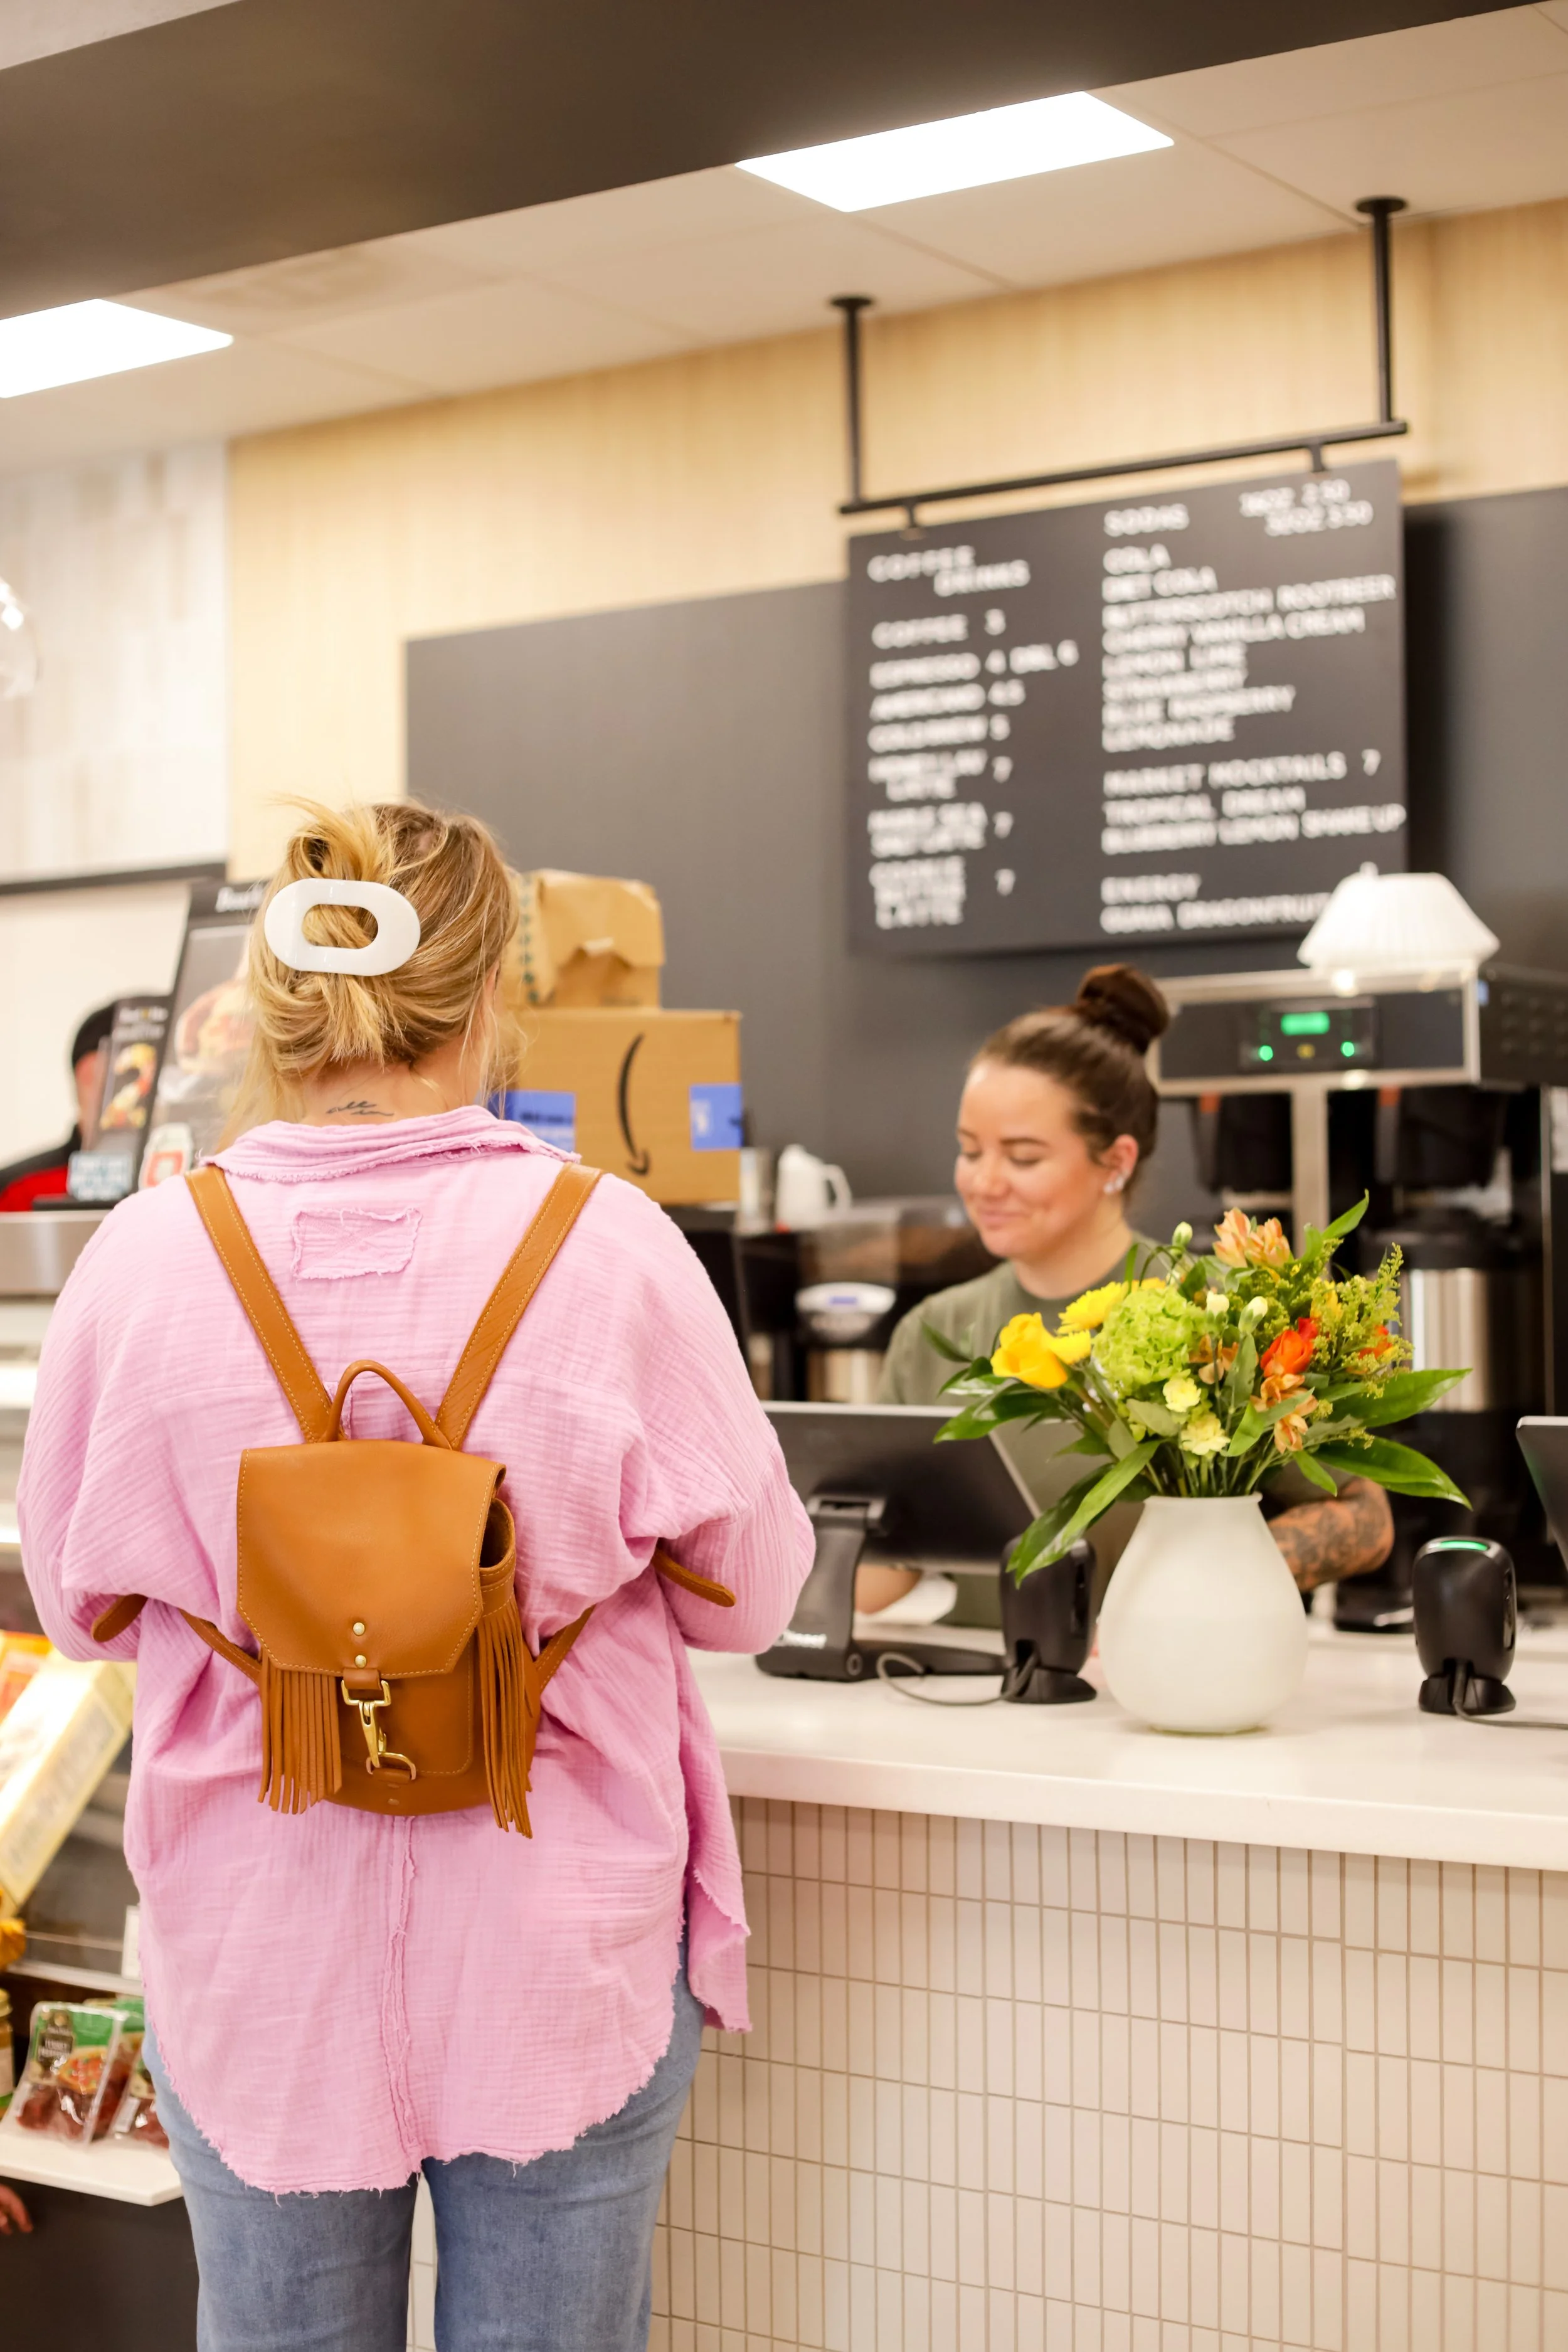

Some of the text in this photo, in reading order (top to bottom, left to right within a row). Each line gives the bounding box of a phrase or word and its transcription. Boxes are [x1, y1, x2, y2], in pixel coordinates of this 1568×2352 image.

[1104, 503, 1189, 537] SODAS
[867, 545, 975, 583] COFFEE
[1103, 543, 1172, 575] COLA
[1102, 565, 1218, 603] DIET COLA
[1102, 587, 1274, 629] BUTTERSCOTCH
[872, 614, 968, 649] COFFEE
[1103, 763, 1206, 798] MARKET
[1208, 751, 1347, 789] MOCKTAILS
[1102, 793, 1217, 827] TROPICAL
[1101, 873, 1202, 904] ENERGY
